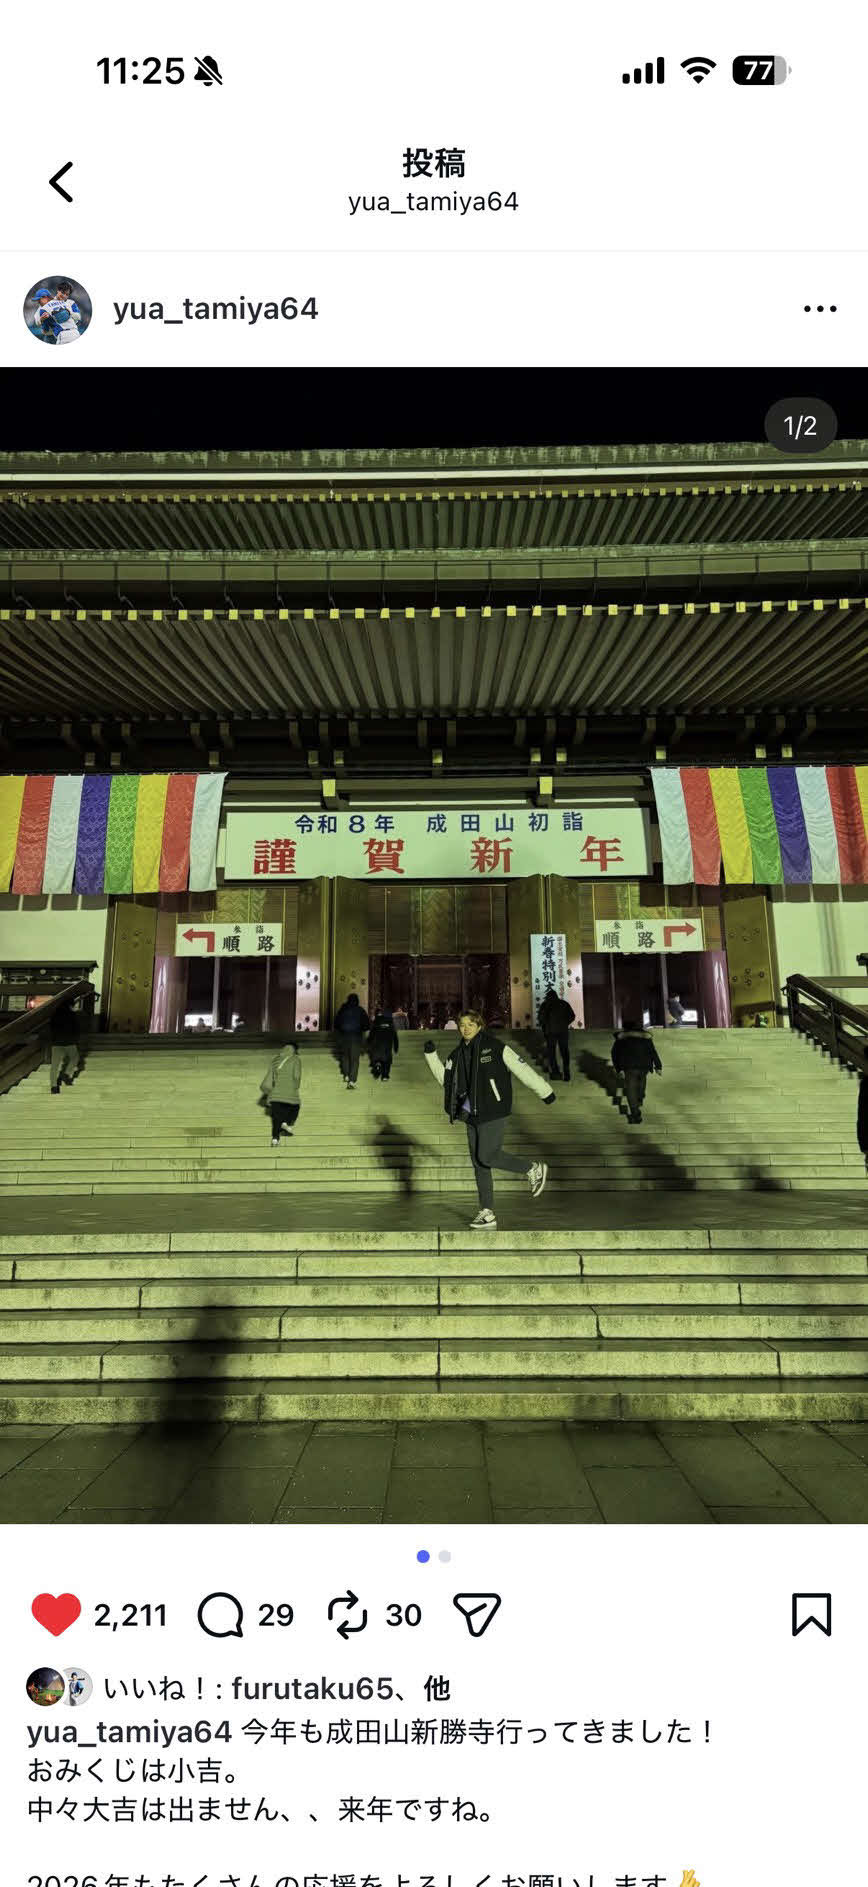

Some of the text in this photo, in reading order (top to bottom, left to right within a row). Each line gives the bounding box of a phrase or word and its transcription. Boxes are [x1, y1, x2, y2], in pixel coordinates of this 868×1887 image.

[96, 57, 185, 85] 11:25
[744, 60, 773, 80] 77
[402, 147, 466, 178] 投稿
[348, 190, 519, 216] yua_tamiya64
[113, 295, 319, 326] yua_tamiya64
[783, 415, 817, 440] 1/2
[426, 811, 584, 833] 成田山初詣
[253, 835, 625, 875] 謹賀新年
[222, 935, 275, 953] 順路
[602, 931, 656, 949] 順路
[94, 1603, 167, 1632] 2,211
[258, 1603, 294, 1627] 29
[386, 1603, 422, 1627] 30
[26, 1717, 711, 1749] yua_tamiya64 今年も成田山新勝寺行ってきました！
[28, 1756, 239, 1784] おみくじは小吉。
[28, 1795, 493, 1823] 中々大吉は出ません、、来年ですね。
